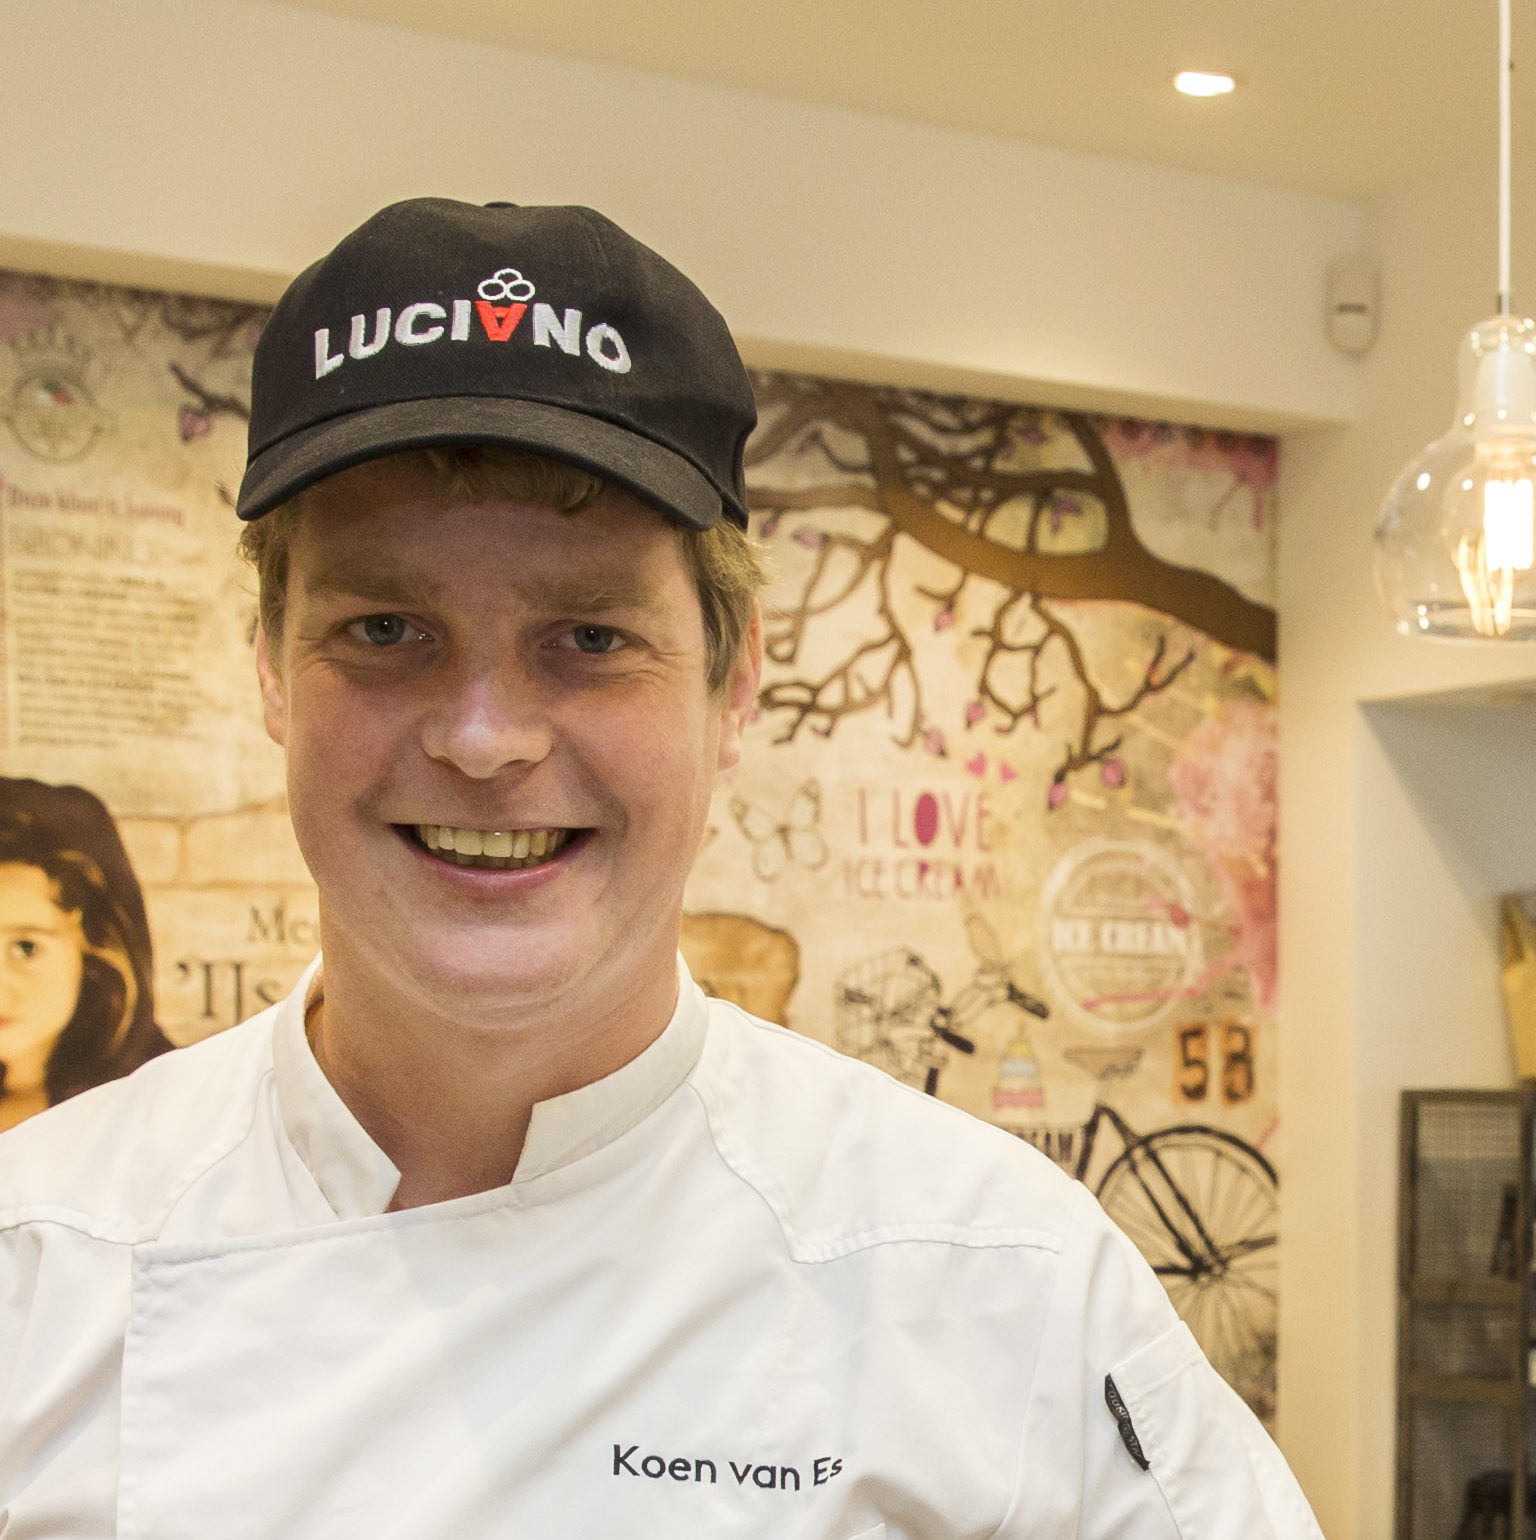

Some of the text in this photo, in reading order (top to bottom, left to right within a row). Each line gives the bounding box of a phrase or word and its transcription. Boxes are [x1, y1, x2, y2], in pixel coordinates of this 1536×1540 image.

[314, 299, 632, 381] LUCIANO
[858, 787, 994, 853] I LOVE
[613, 1444, 717, 1484] Koen
[729, 1460, 801, 1492] van
